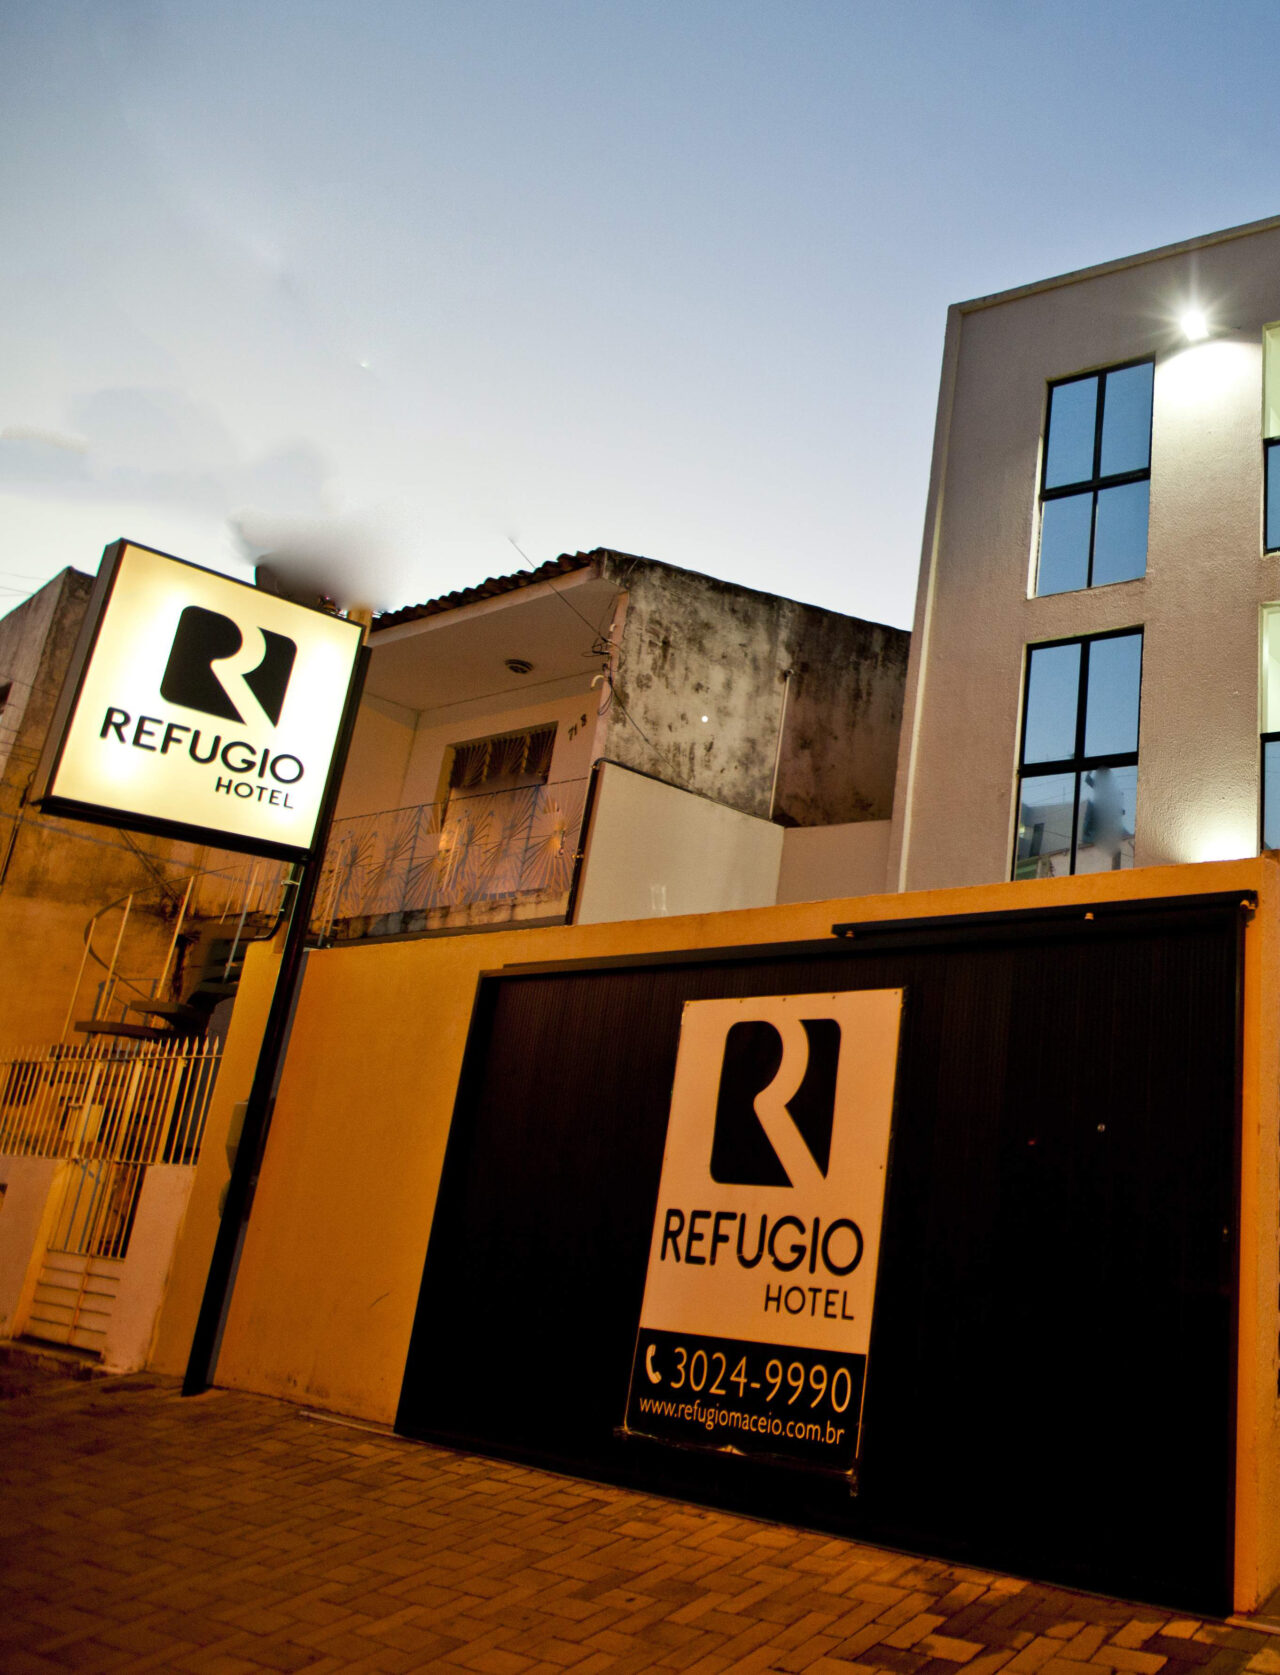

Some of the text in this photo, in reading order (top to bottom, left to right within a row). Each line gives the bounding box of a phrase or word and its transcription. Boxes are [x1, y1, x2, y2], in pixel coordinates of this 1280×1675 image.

[99, 706, 305, 785] REFUGIO
[215, 776, 294, 810] HOTEL
[660, 1208, 864, 1277] REFUGIO
[764, 1283, 855, 1321] HOTEL
[670, 1346, 852, 1413] 3024-9990
[639, 1397, 845, 1444] www.refugiomaceio.com.br
